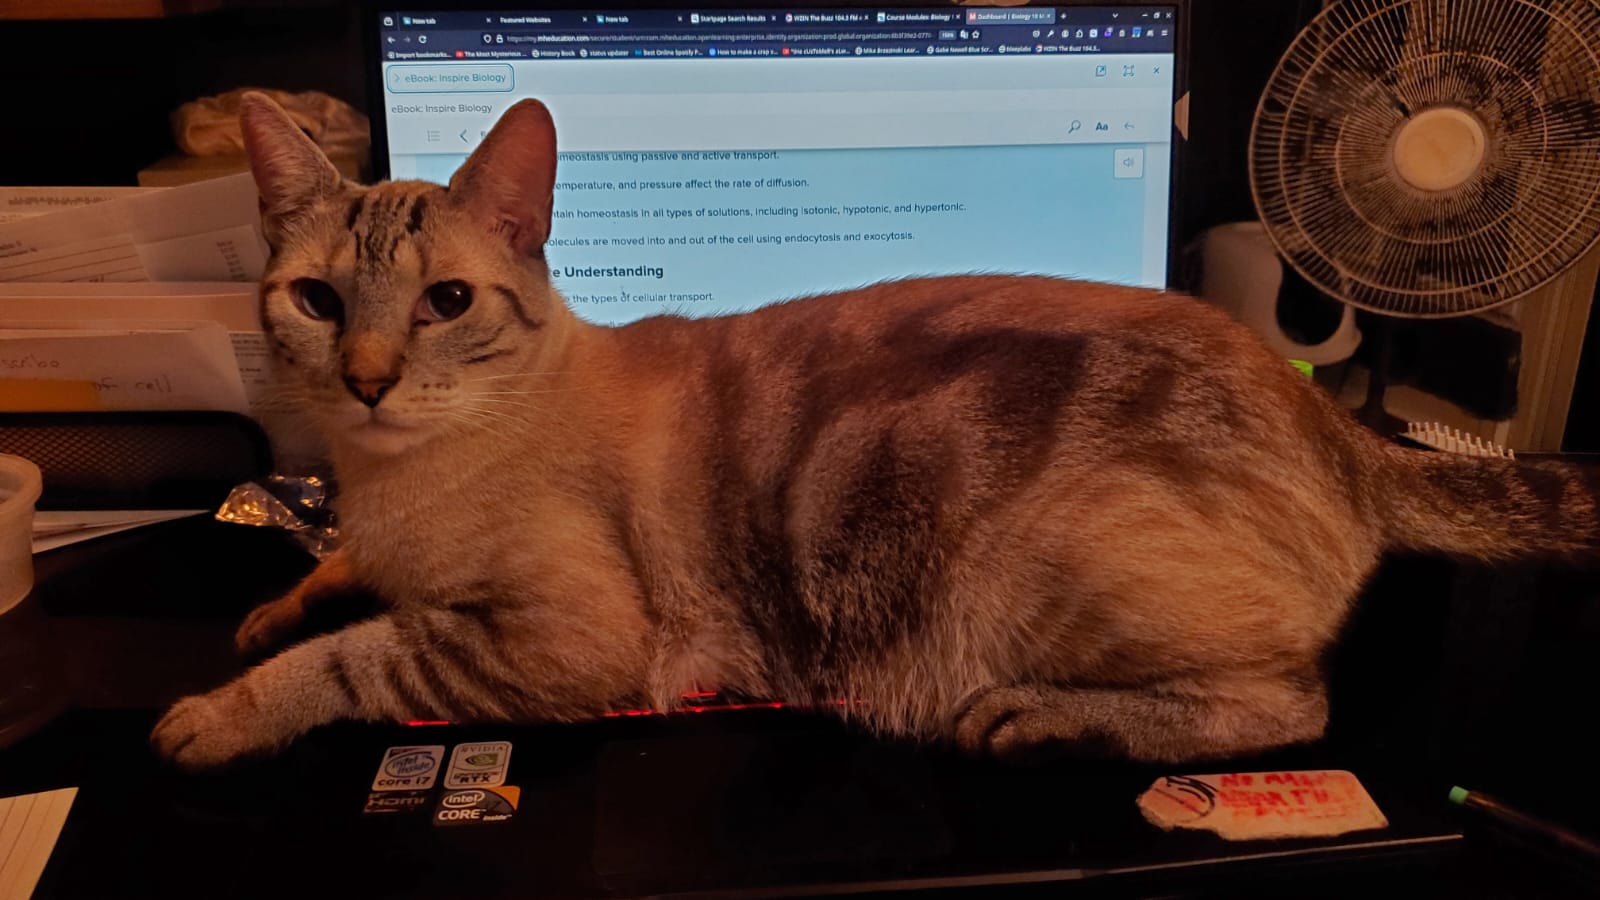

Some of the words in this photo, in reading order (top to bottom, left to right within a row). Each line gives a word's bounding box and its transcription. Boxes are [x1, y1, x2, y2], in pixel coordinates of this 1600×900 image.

[700, 15, 727, 23] Startpage
[930, 13, 951, 22] Biology
[405, 74, 437, 83] eBook:
[439, 74, 470, 84] Inspire
[472, 73, 506, 83] Biology
[391, 104, 423, 114] eBook:
[425, 104, 456, 115] Inspire
[458, 103, 493, 114] Biology
[1095, 122, 1109, 131] Aa
[558, 152, 609, 161] meostasis
[612, 152, 639, 163] using
[641, 151, 678, 162] passive
[681, 151, 700, 160] and
[702, 151, 732, 160] active
[733, 151, 780, 161] transport.
[555, 180, 616, 191] emperature,
[618, 180, 637, 189] and
[640, 181, 682, 191] pressure
[685, 179, 713, 188] affect
[714, 179, 730, 188] the
[732, 179, 752, 188] rate
[754, 178, 764, 187] of
[766, 178, 810, 188] diffusion.
[576, 208, 639, 218] homeostasis
[641, 208, 650, 217] in
[652, 208, 664, 217] all
[666, 209, 693, 219] types
[695, 207, 706, 217] of
[707, 207, 753, 217] solutions,
[755, 206, 799, 217] including
[801, 206, 840, 216] isotonic,
[842, 205, 892, 216] hypotonic,
[894, 204, 912, 213] and
[914, 202, 967, 214] hypertonic.
[547, 237, 591, 247] olecules
[592, 238, 609, 246] are
[611, 236, 645, 246] moved
[647, 236, 666, 245] into
[668, 236, 687, 245] and
[688, 236, 705, 245] out
[706, 235, 717, 244] of
[719, 235, 735, 244] the
[737, 235, 754, 244] cell
[756, 234, 782, 245] using
[784, 232, 841, 243] endocytosis
[843, 232, 861, 242] and
[863, 231, 915, 242] exocytosis.
[564, 265, 664, 279] Understanding
[573, 294, 588, 303] the
[591, 294, 618, 305] types
[620, 293, 630, 303] of
[632, 293, 667, 302] cellular
[377, 778, 412, 787] core
[415, 776, 432, 785] i7
[449, 793, 478, 804] intel
[438, 809, 481, 821] CORE
